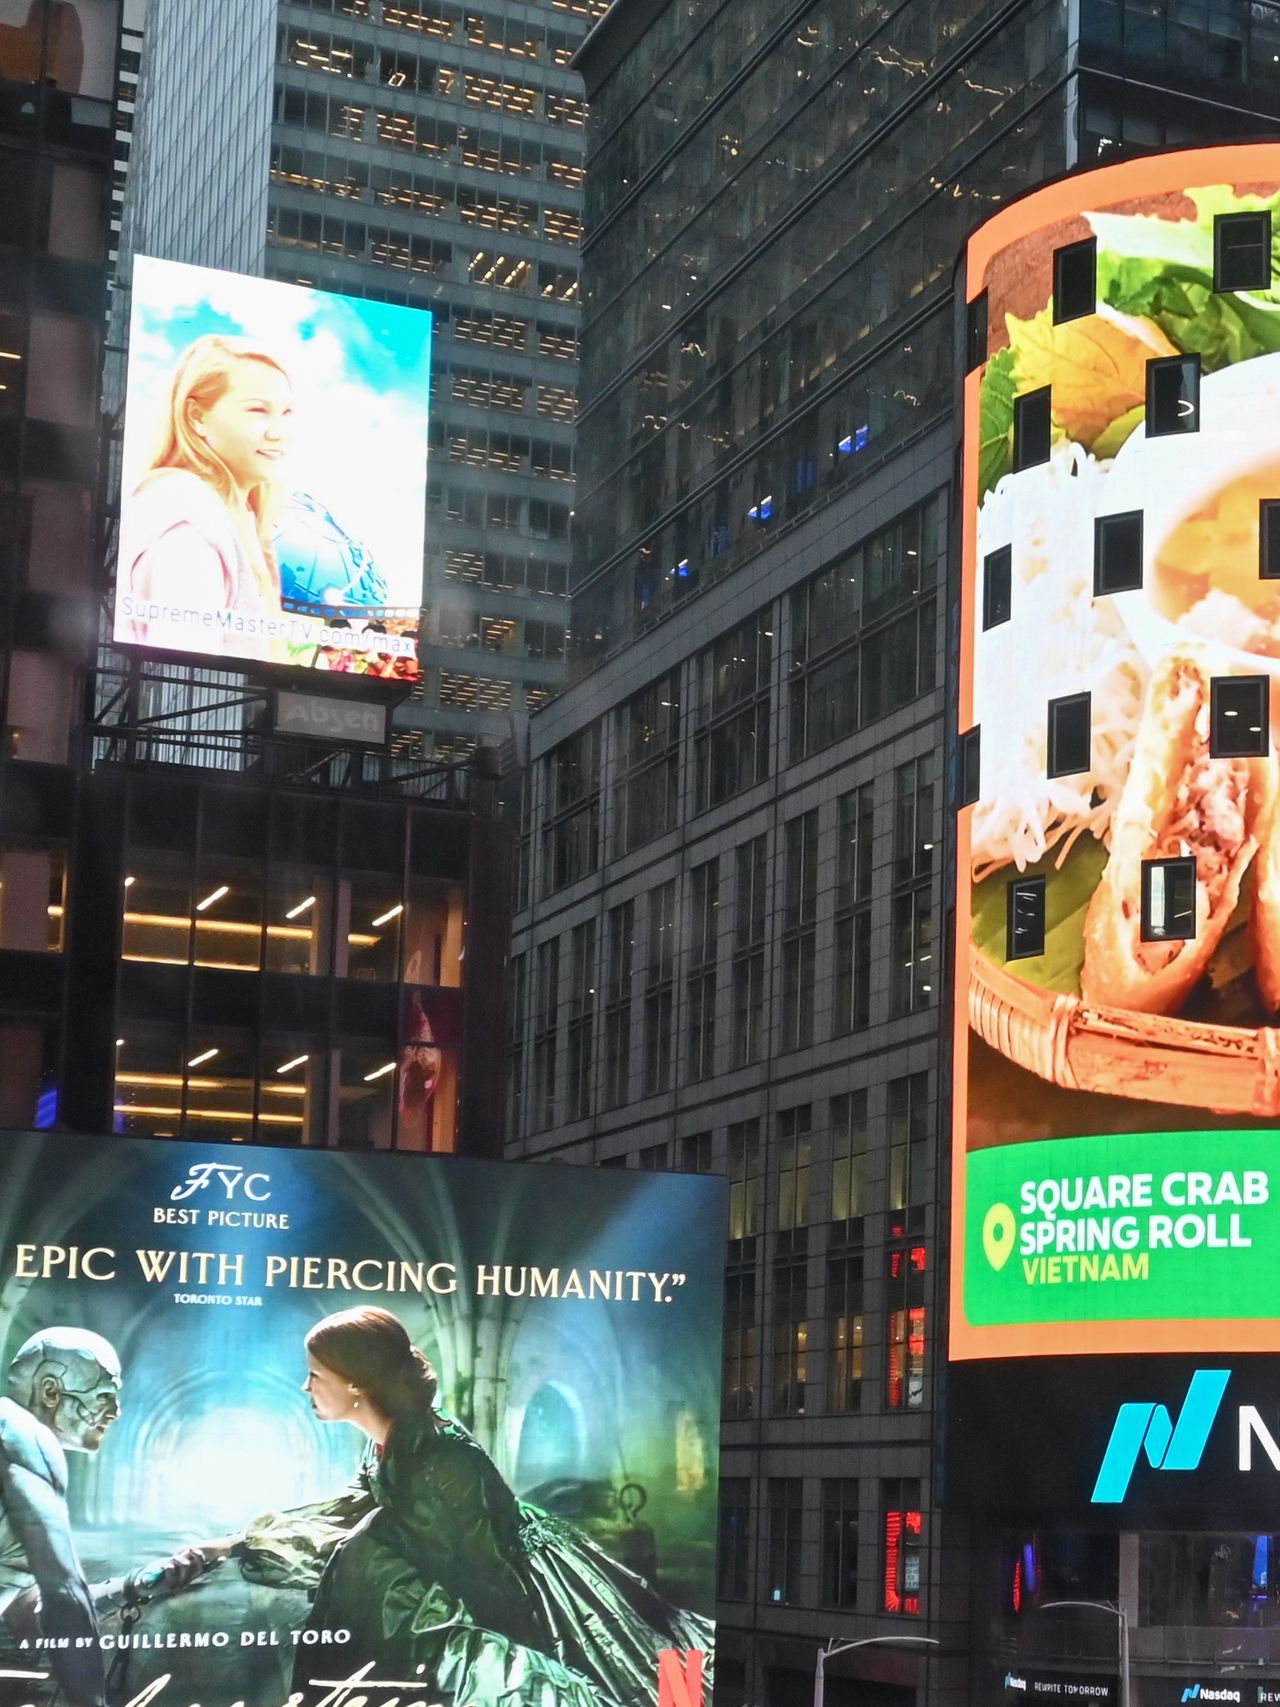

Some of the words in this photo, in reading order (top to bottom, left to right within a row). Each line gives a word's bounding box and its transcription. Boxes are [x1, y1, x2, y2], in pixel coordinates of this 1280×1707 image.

[121, 596, 411, 653] SupremeMasterTVcom/max
[285, 699, 380, 733] Absen
[170, 1162, 271, 1201] FYC
[1020, 1173, 1153, 1221] SQUARE
[1161, 1170, 1270, 1206] CRAB
[153, 1207, 200, 1225] BEST
[208, 1210, 290, 1230] PICTURE
[1019, 1215, 1140, 1256] SPRING
[1149, 1213, 1252, 1249] ROLL
[14, 1243, 117, 1281] EPIC
[136, 1249, 245, 1286] WITH
[265, 1255, 458, 1294] PIERCING
[1022, 1252, 1149, 1286] VIETNAM
[174, 1293, 232, 1305] TORONTO
[235, 1295, 262, 1307] STAR
[19, 1639, 29, 1650] A
[35, 1637, 70, 1649] FILM
[75, 1637, 94, 1648] BY
[99, 1631, 230, 1650] GUILLERMO
[240, 1630, 280, 1647] DEL
[290, 1629, 351, 1646] TORO
[1034, 1682, 1061, 1693] REWRITE
[1064, 1684, 1109, 1697] TOMORROW
[1200, 1688, 1240, 1703] Nasdaq
